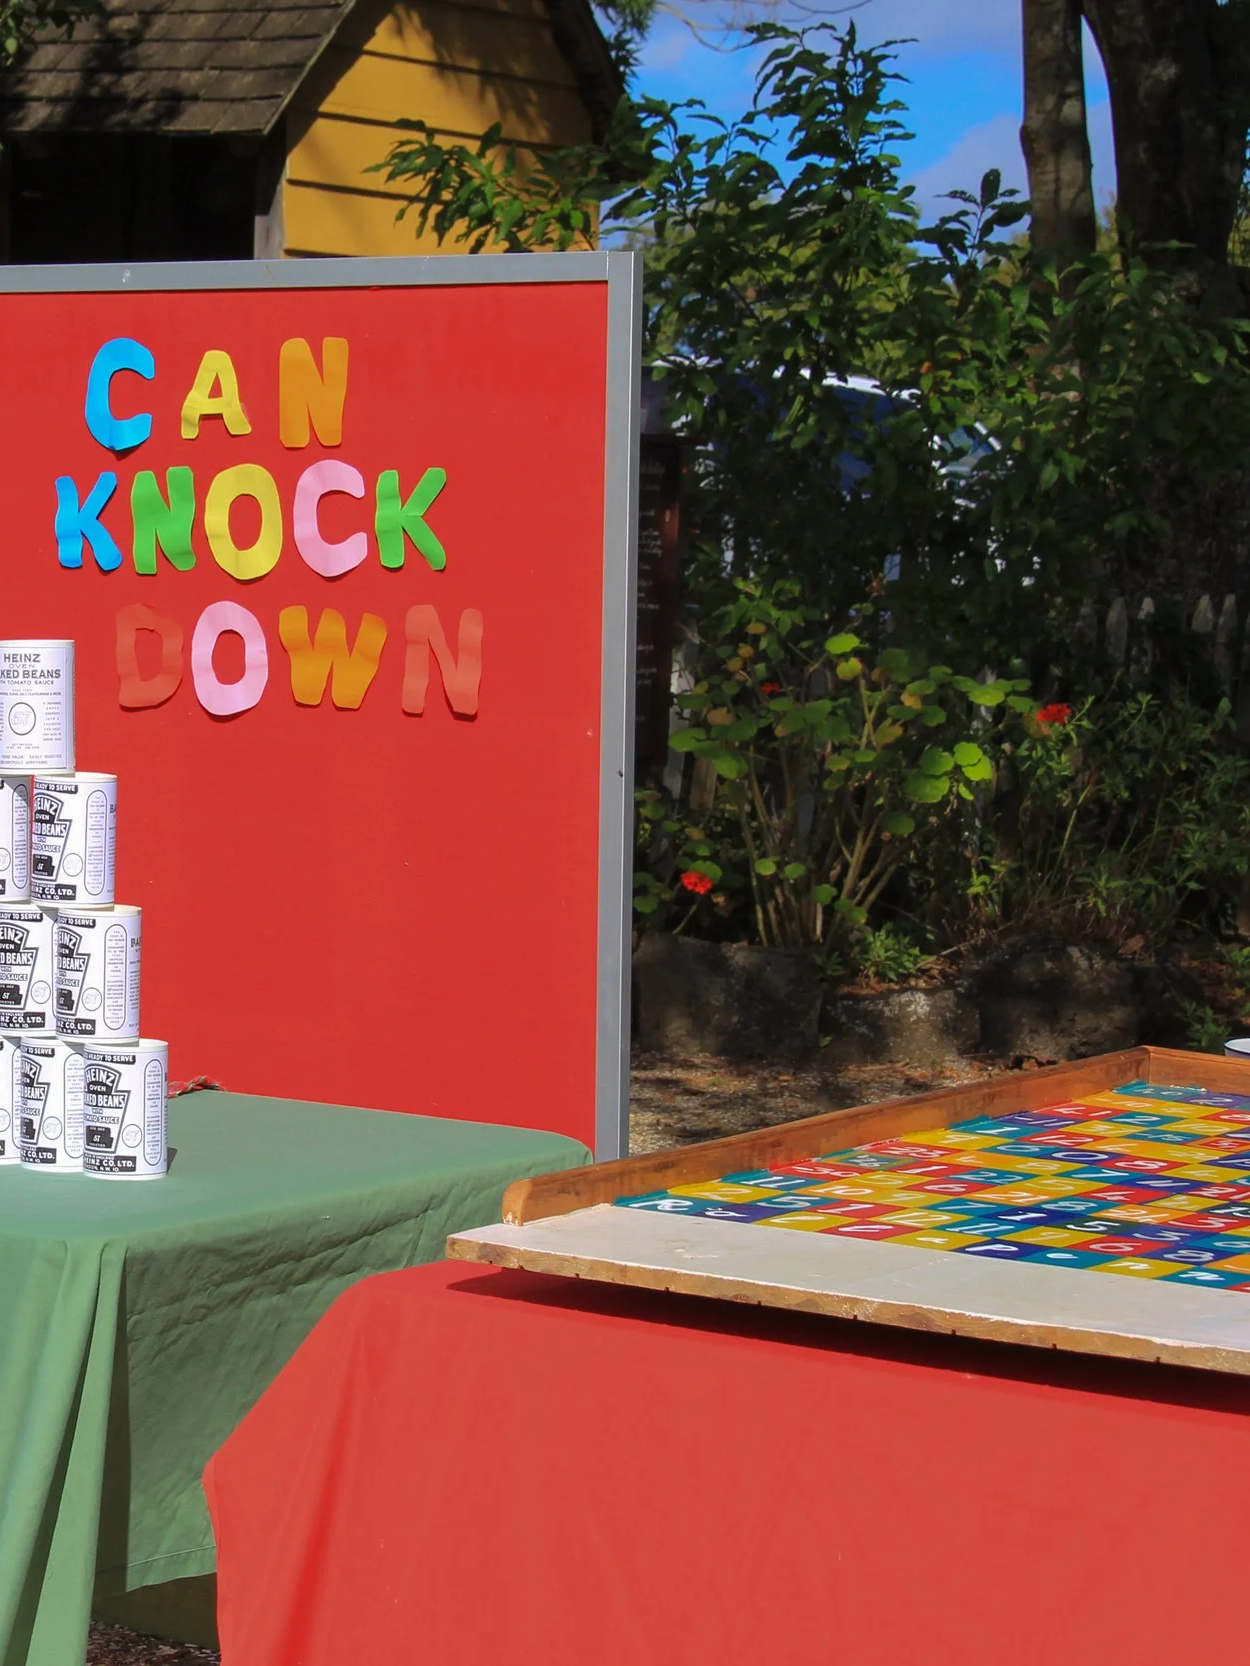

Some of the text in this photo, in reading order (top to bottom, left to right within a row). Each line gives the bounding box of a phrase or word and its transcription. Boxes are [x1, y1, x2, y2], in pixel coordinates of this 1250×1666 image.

[85, 337, 348, 451] CAN
[54, 459, 447, 580] KNOCK
[3, 653, 41, 663] HEINZ
[115, 600, 483, 716] DOWN
[22, 669, 60, 679] BEANS
[56, 785, 75, 793] SERVE
[41, 822, 67, 836] BEANS
[58, 889, 75, 897] LTD.
[21, 913, 41, 921] SERVE
[5, 952, 33, 964] BEANS
[62, 957, 84, 970] BEANS
[85, 1067, 116, 1086] HEINZ
[24, 1086, 45, 1099] BEANS
[98, 1094, 125, 1107] BEANS
[1051, 1151, 1109, 1161] 0
[810, 1185, 874, 1196] 10
[757, 1195, 821, 1208] 5
[1041, 1200, 1098, 1212] 8
[1066, 1219, 1121, 1232] 5
